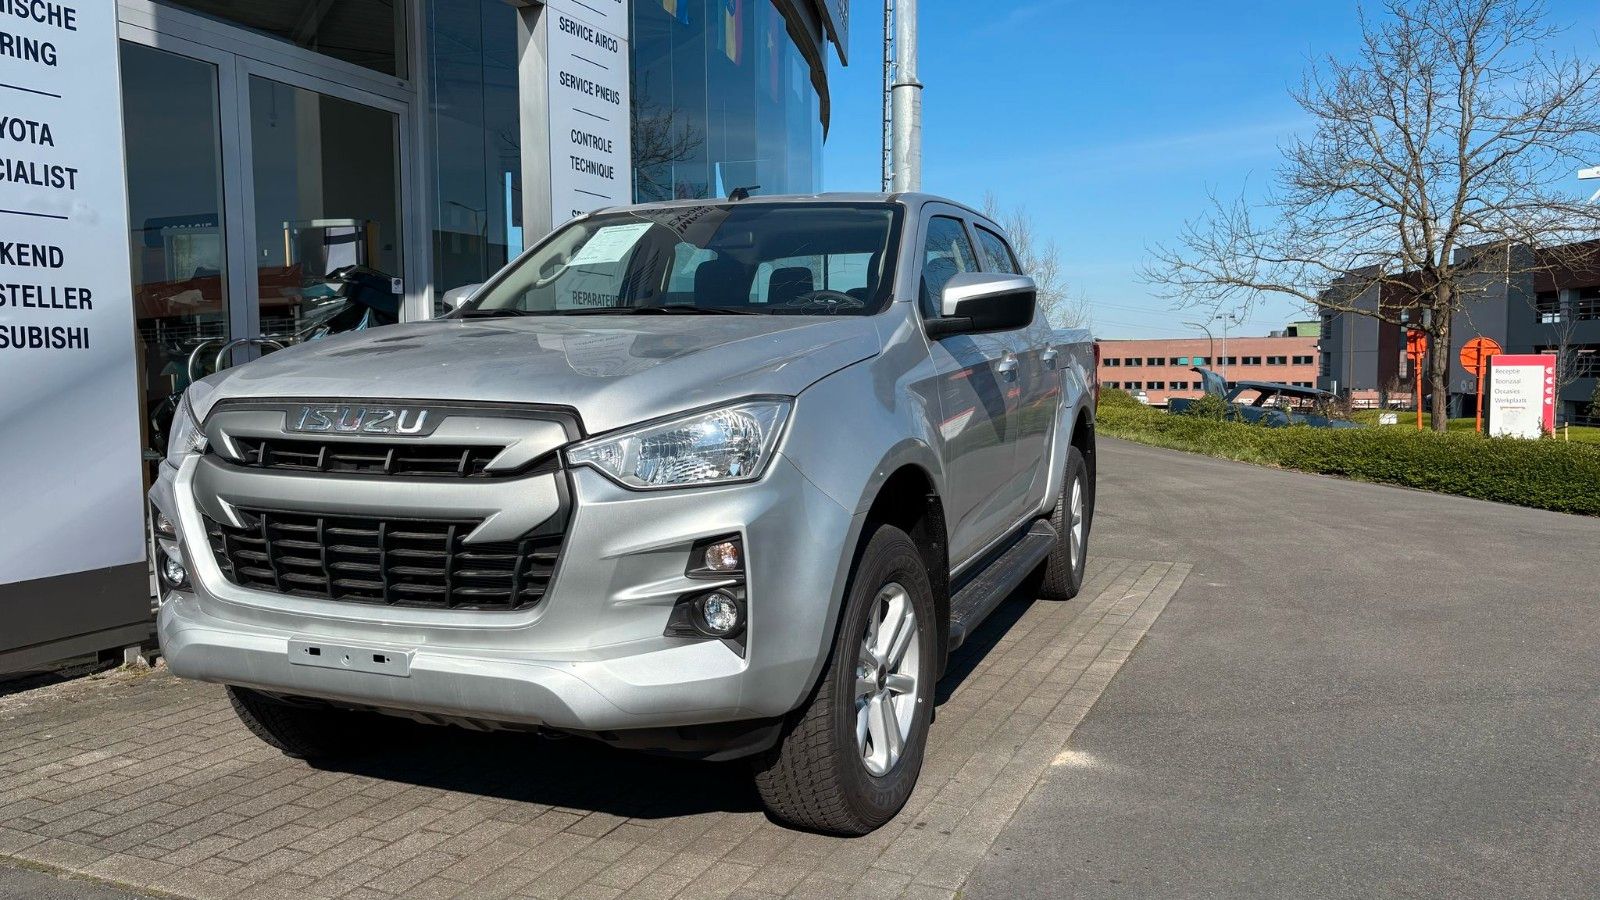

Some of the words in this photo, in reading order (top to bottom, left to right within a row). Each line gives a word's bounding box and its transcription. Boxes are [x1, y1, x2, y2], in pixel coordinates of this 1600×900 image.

[559, 16, 594, 43] SERVICE
[595, 31, 618, 53] AIRCO
[0, 31, 57, 67] RING
[559, 70, 594, 96] SERVICE
[595, 83, 620, 105] PNEUS
[570, 128, 613, 154] CONTROLE
[570, 155, 614, 180] TECHNIQUE
[0, 241, 64, 268] KEND
[295, 407, 428, 433] ISUZU
